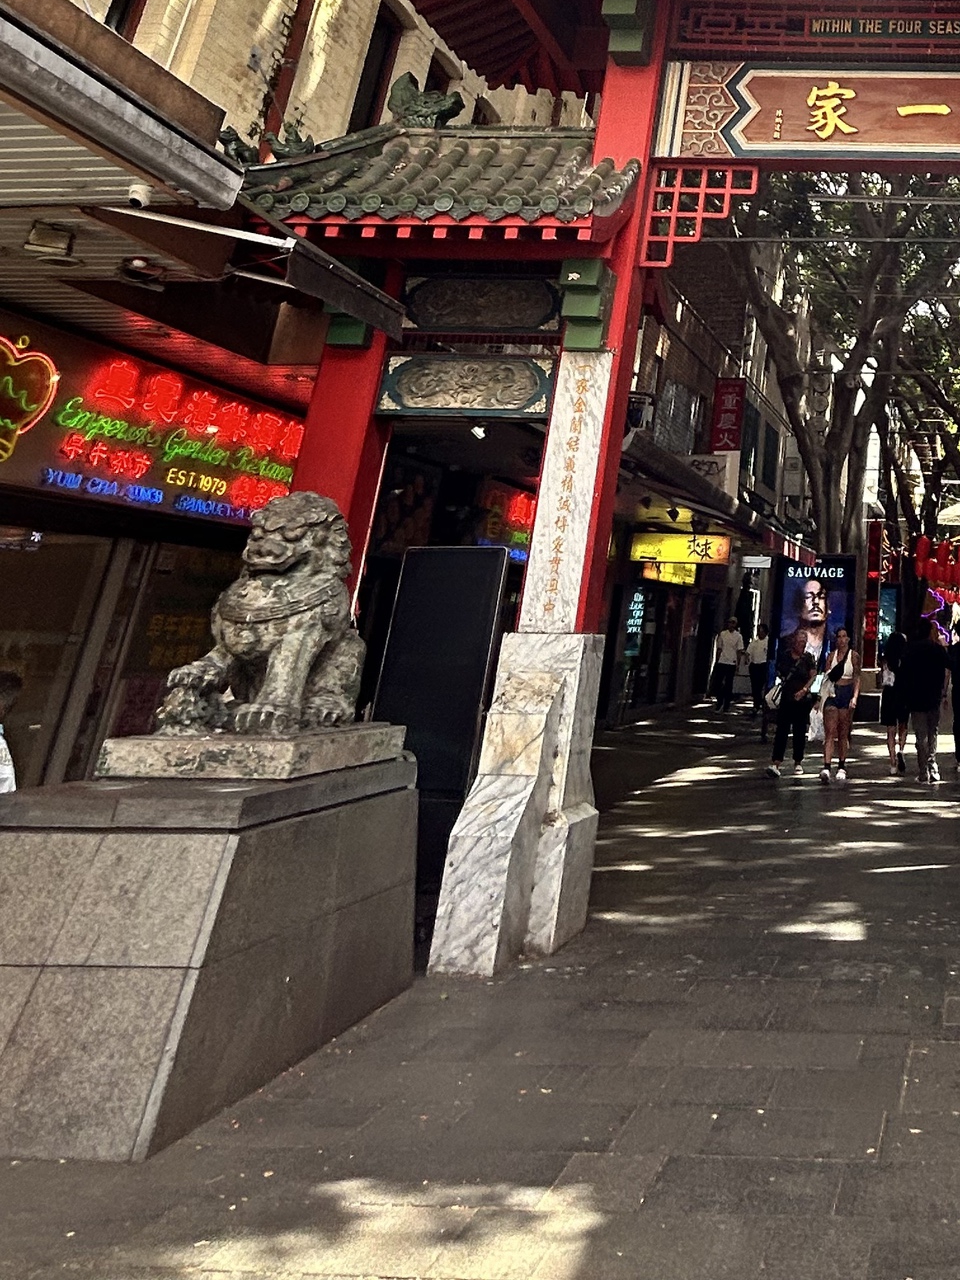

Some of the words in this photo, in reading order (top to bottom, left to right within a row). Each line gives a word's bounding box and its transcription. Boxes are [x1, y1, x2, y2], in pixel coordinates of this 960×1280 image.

[811, 19, 852, 33] WITHIN
[858, 20, 882, 33] THE
[888, 20, 922, 34] FOUR
[928, 20, 960, 34] SEAS
[47, 468, 83, 489] YUM
[787, 566, 845, 578] SAUVAGE
